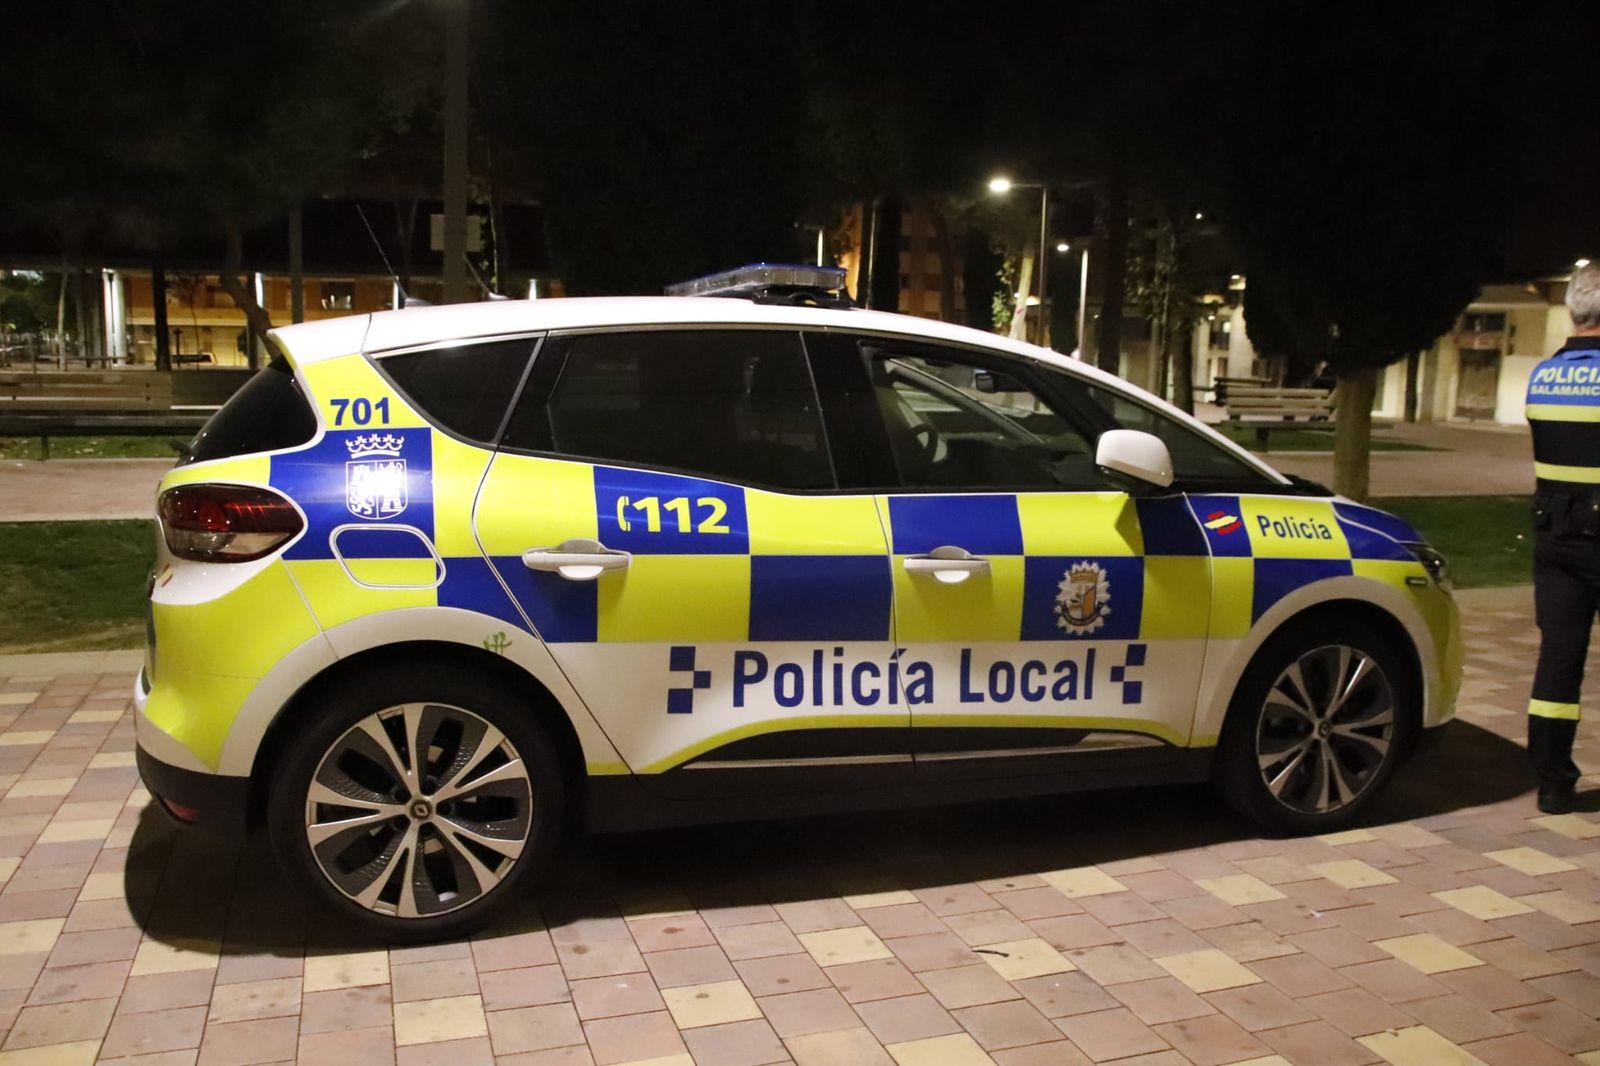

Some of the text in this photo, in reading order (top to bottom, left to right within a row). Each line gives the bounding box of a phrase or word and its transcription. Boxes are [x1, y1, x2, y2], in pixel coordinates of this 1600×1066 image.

[1533, 366, 1600, 384] POLICI
[330, 397, 390, 426] 701
[632, 496, 731, 534] 112
[1257, 515, 1333, 540] Policía
[732, 648, 1096, 708] Policía Local
